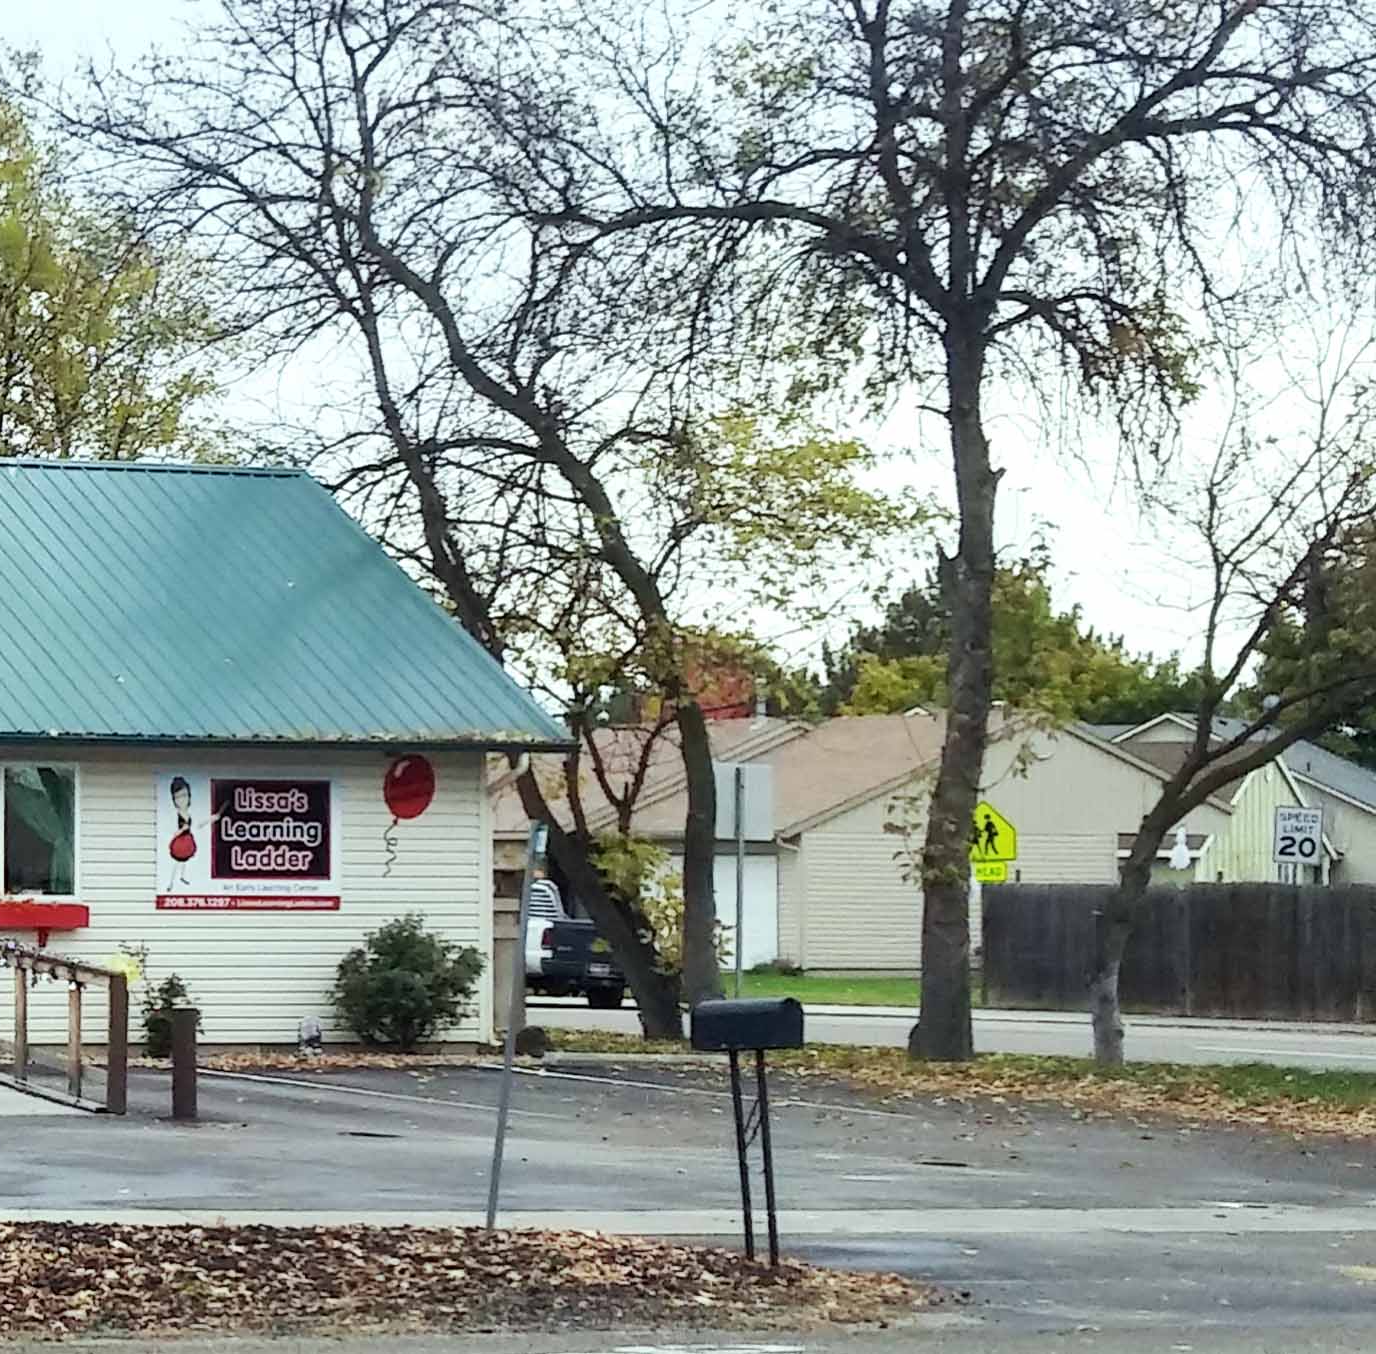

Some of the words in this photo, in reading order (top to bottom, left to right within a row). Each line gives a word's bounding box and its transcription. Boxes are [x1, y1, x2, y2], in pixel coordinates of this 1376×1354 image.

[234, 788, 309, 813] Lissa's
[1279, 812, 1319, 824] SPEED
[1282, 823, 1314, 834] LIMIT
[221, 817, 321, 847] Learning
[231, 845, 314, 870] Ladder
[1278, 836, 1316, 858] 20
